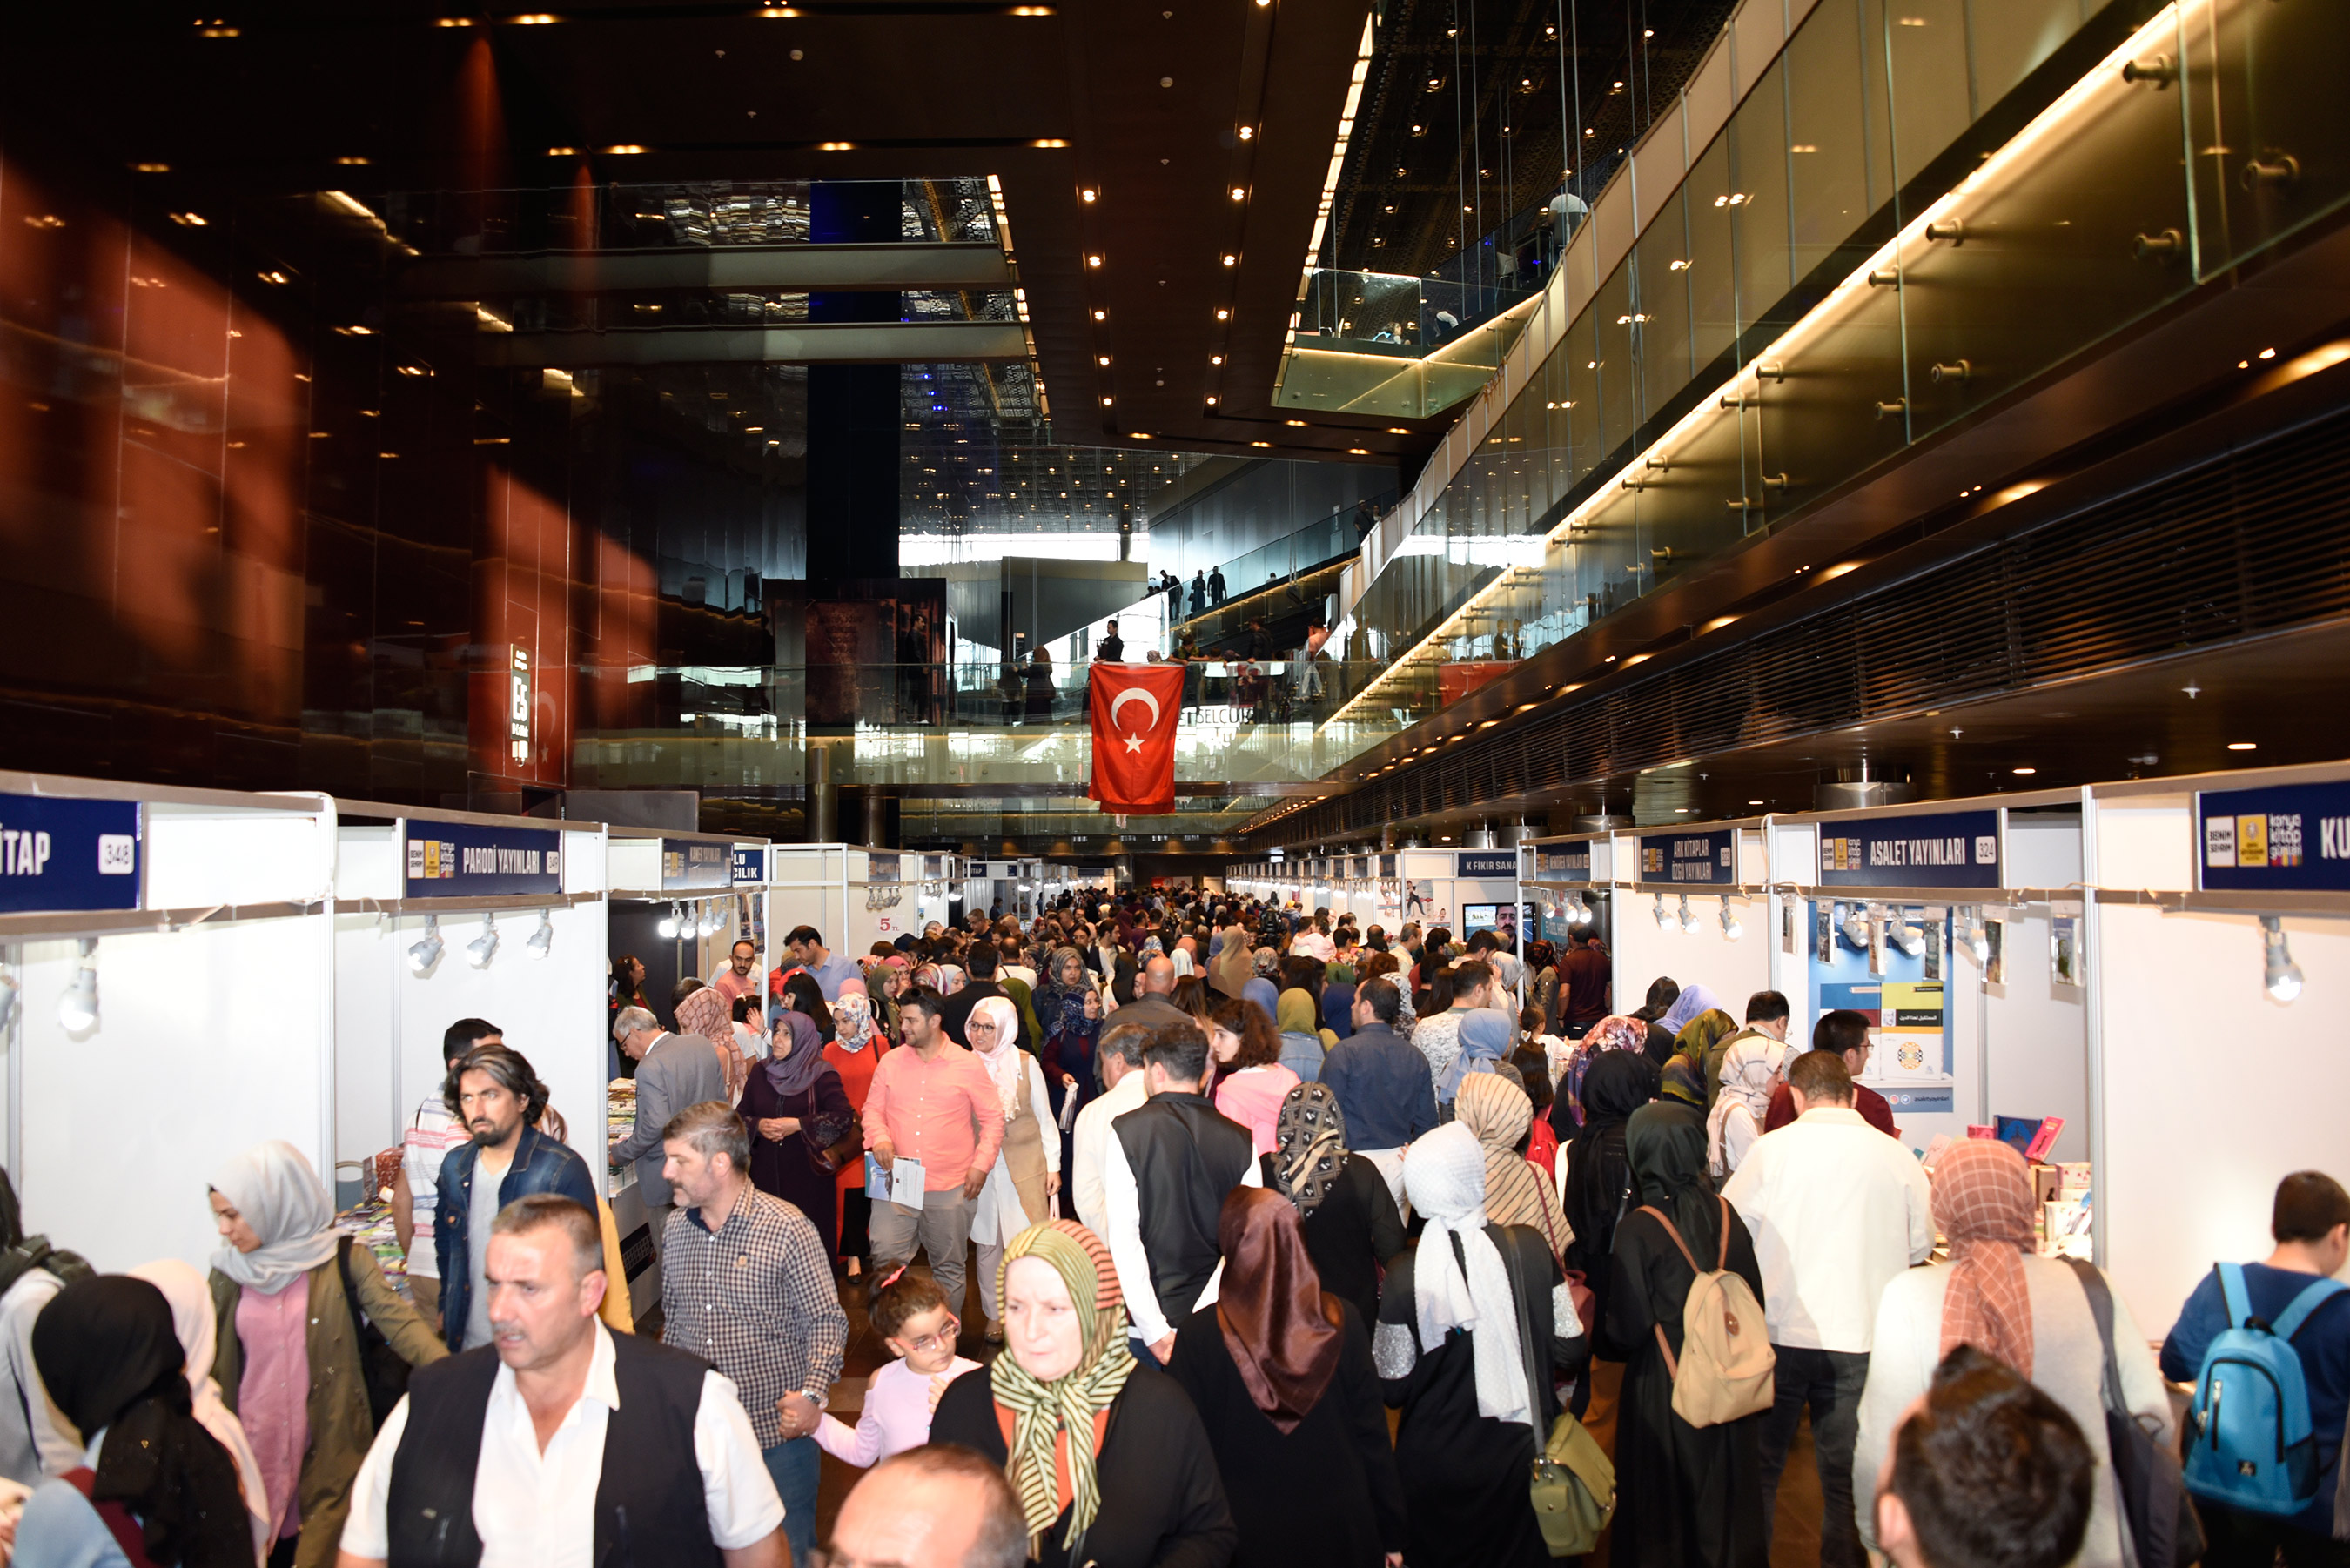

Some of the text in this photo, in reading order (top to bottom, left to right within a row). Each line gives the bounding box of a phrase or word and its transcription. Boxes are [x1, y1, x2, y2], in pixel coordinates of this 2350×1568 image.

[105, 843, 131, 865] 348
[463, 844, 496, 874] PARODİ
[498, 848, 540, 874] YAYINLARI
[1870, 840, 1906, 866] ASALET
[1908, 837, 1965, 866] YAYINLARI
[1978, 842, 1994, 858] 324
[1466, 861, 1472, 870] K
[1473, 860, 1494, 870] FİKİR
[879, 918, 891, 931] 5
